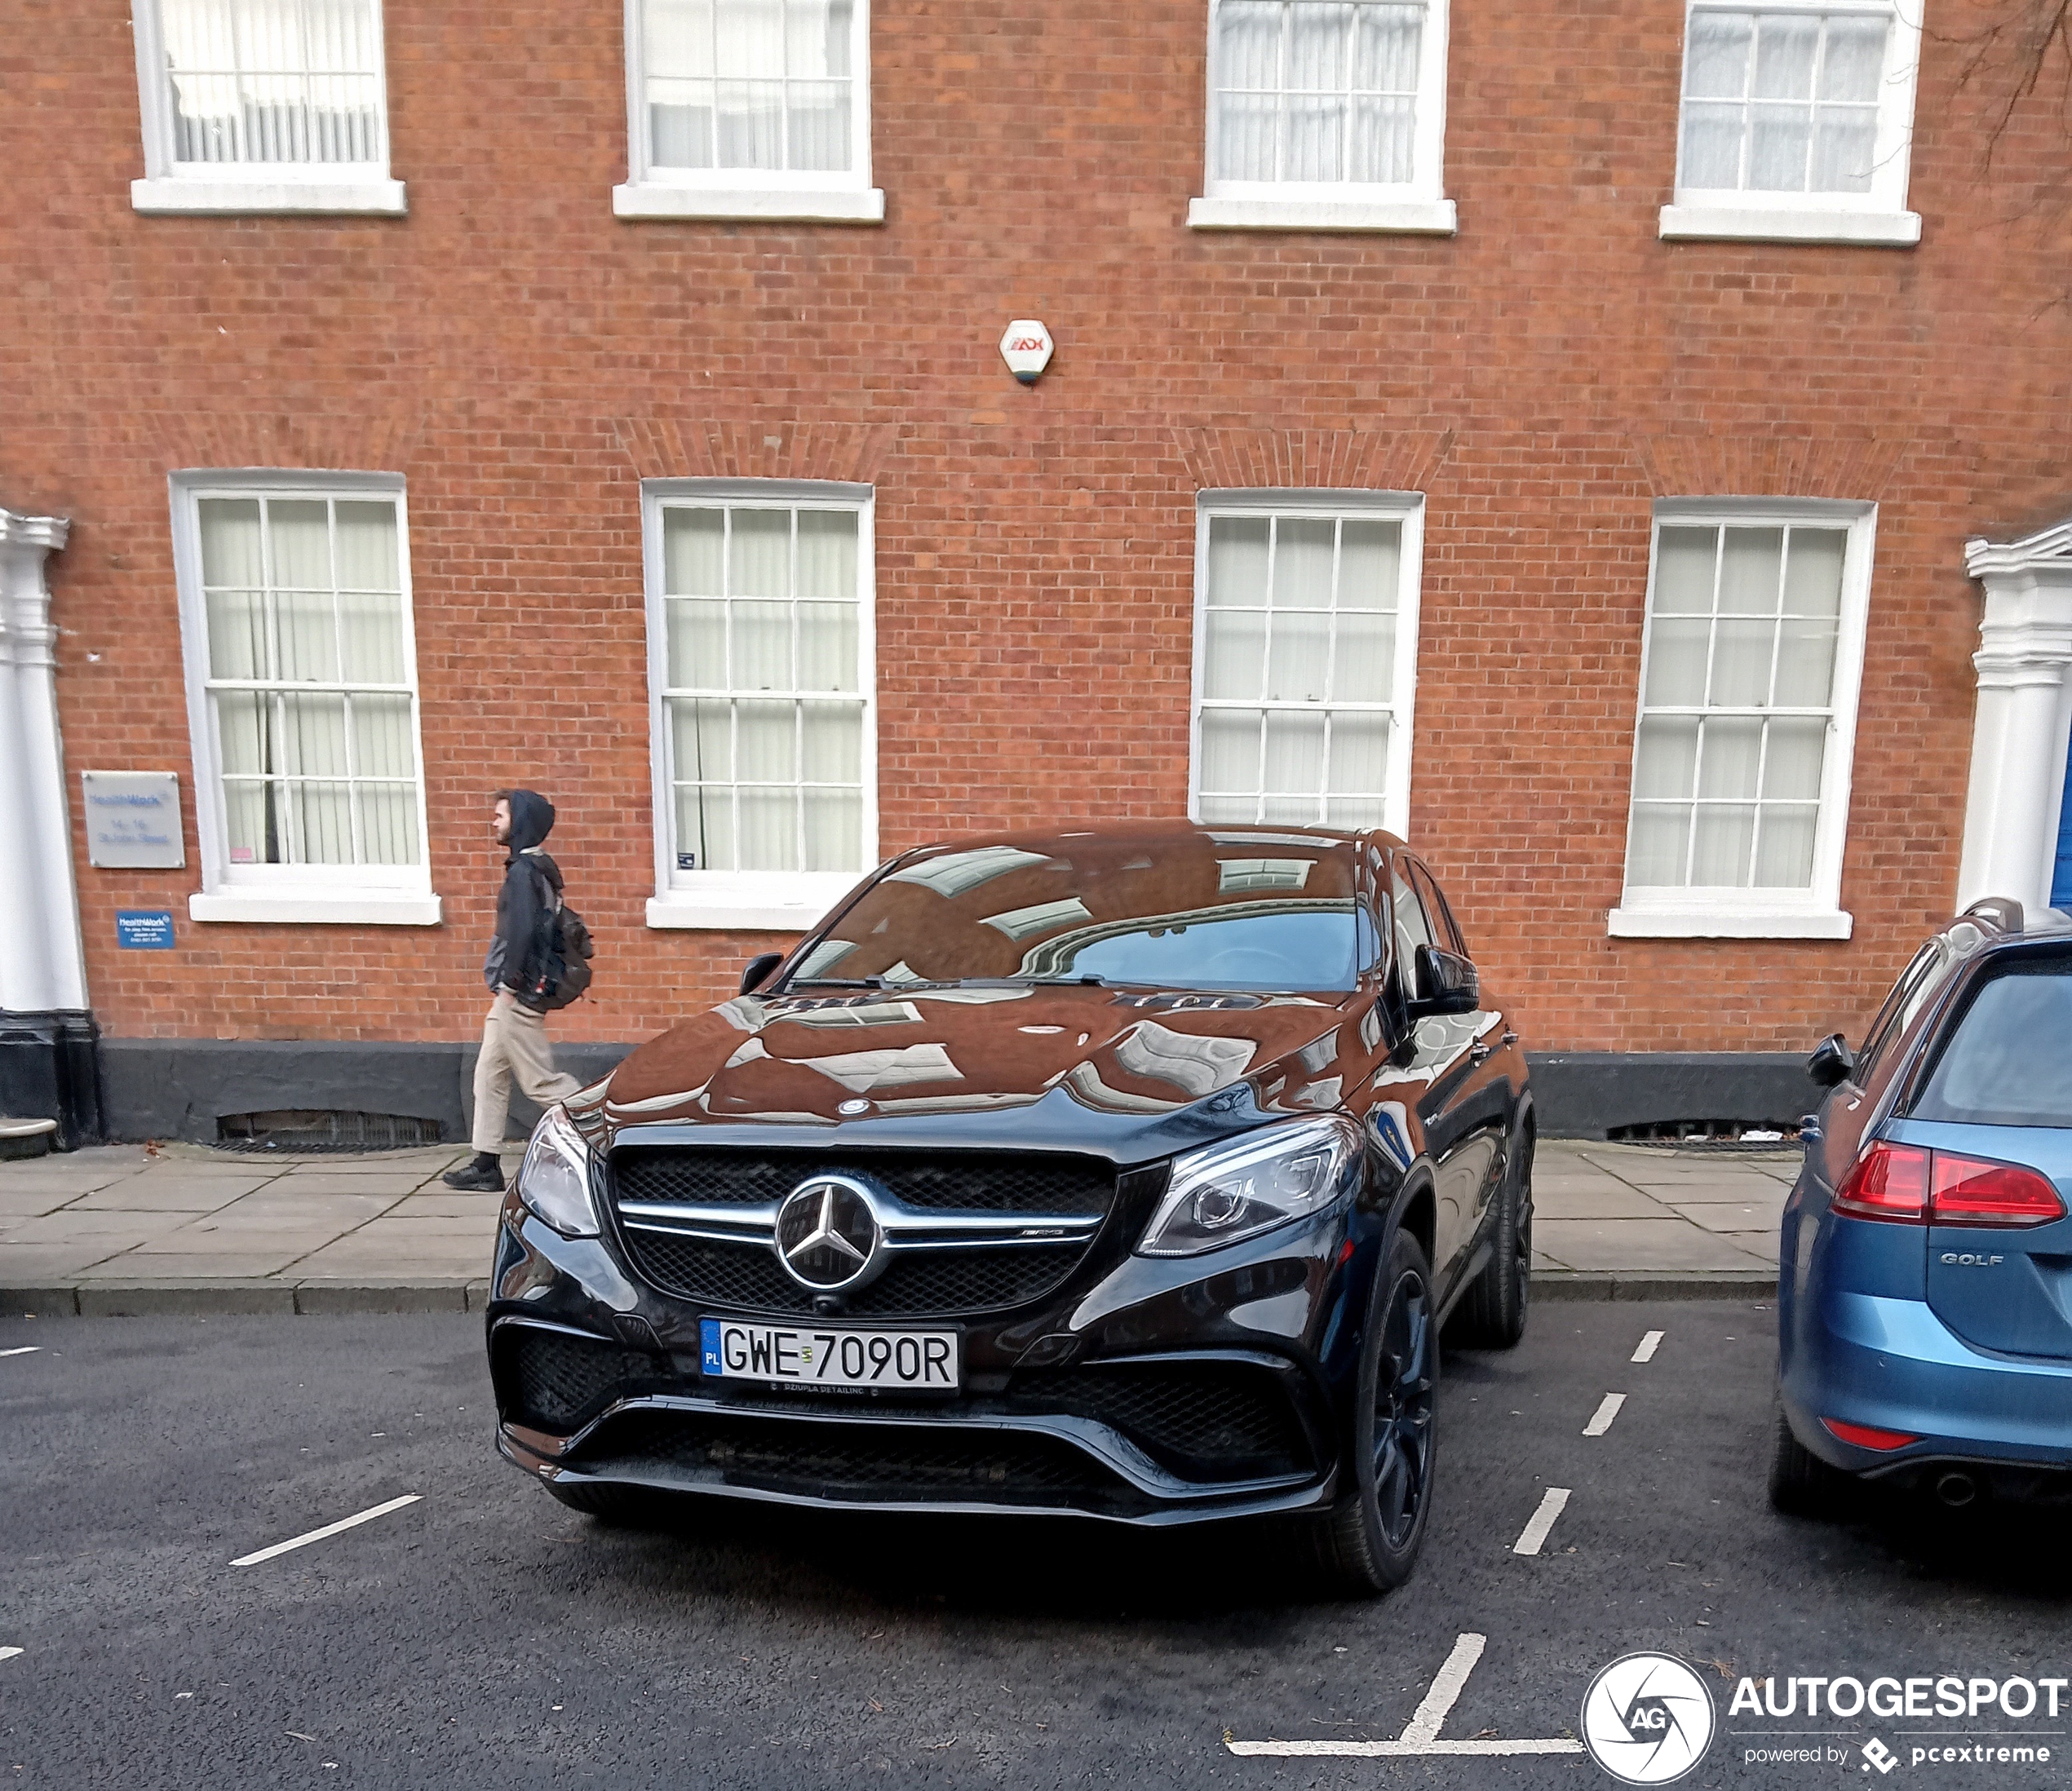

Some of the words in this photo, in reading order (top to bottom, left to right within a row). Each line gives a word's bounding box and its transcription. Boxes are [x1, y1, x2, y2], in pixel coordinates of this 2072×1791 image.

[119, 918, 165, 926] HealthWork
[1941, 1253, 2004, 1267] GOLF
[706, 1352, 719, 1366] PL
[724, 1327, 800, 1376] GWE
[813, 1333, 952, 1382] 7090R
[783, 1383, 818, 1393] DZIUPLA
